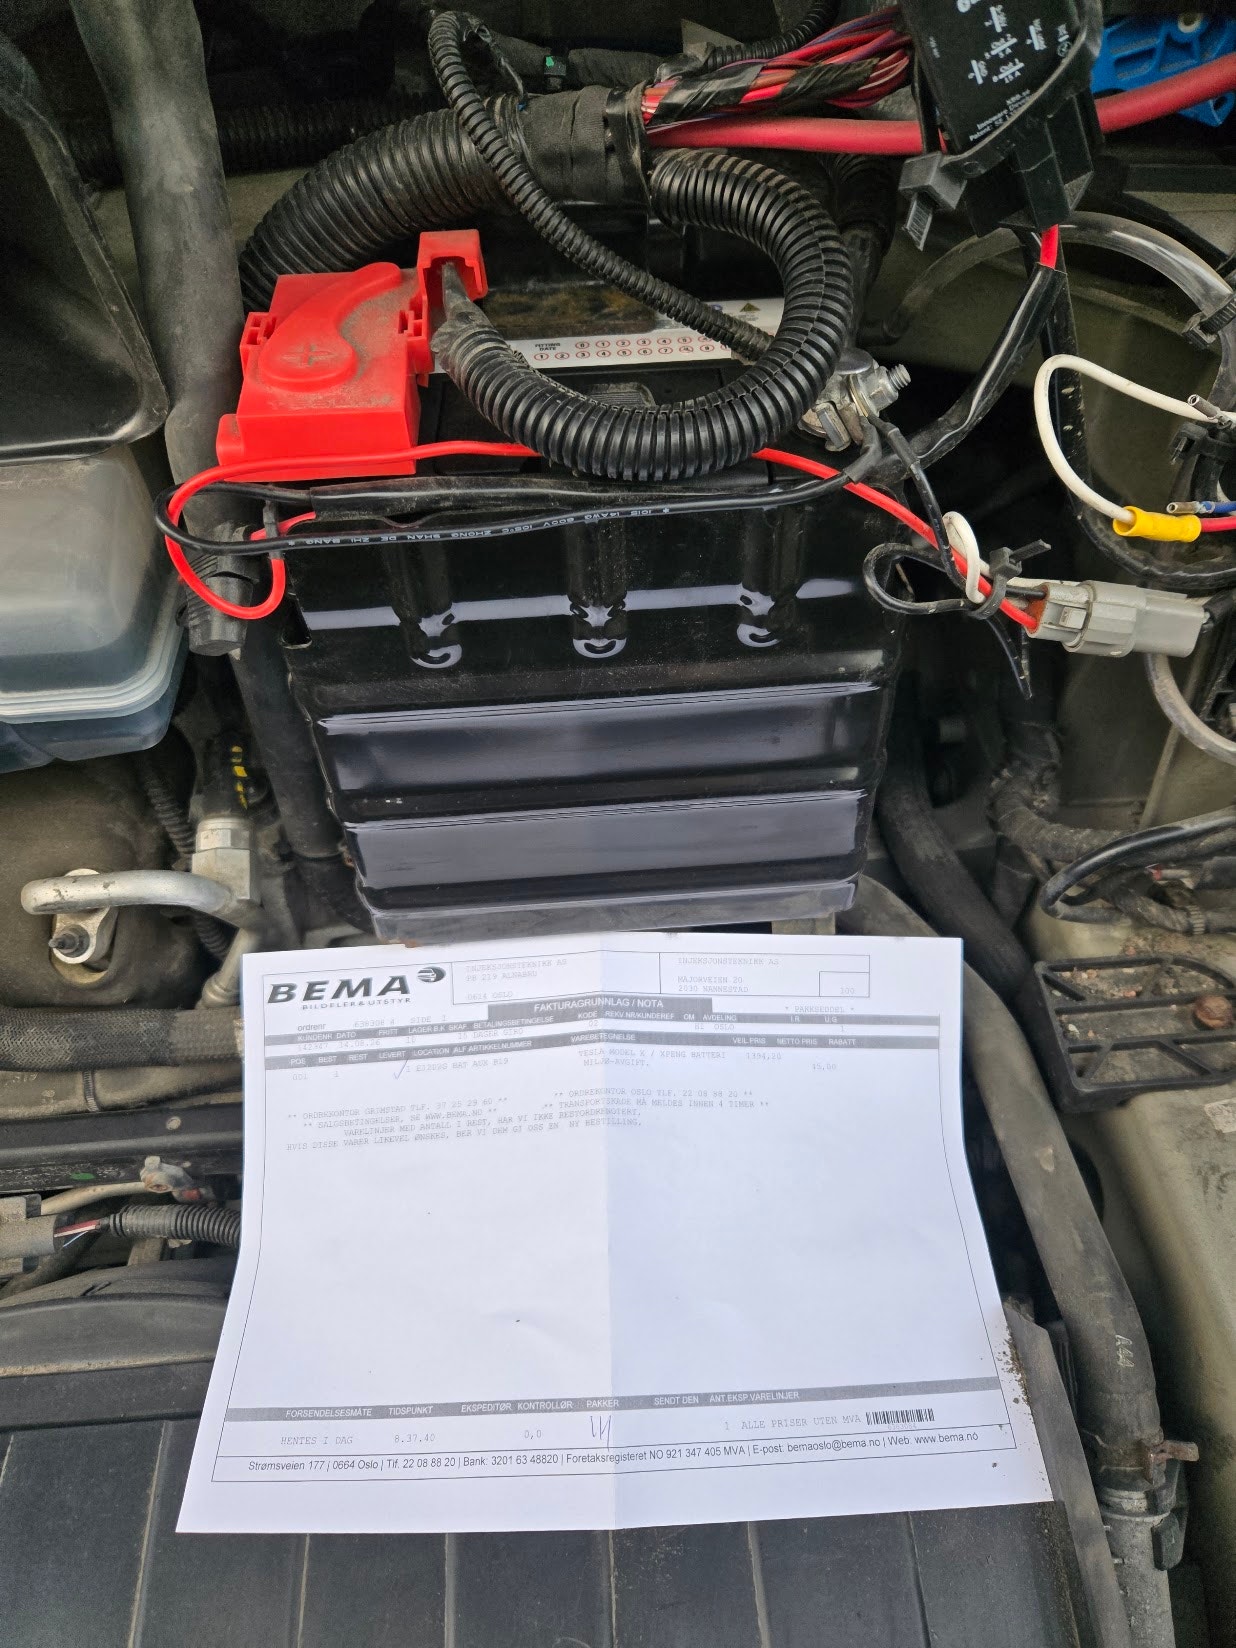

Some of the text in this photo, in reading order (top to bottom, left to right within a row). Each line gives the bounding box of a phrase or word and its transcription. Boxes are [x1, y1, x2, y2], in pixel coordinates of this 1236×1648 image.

[543, 516, 575, 527] 600V
[584, 510, 620, 520] 14AWG
[450, 530, 492, 538] ZHONG
[556, 958, 568, 966] AS
[678, 957, 764, 966] INJEKSJONSTEKNIKK
[501, 970, 538, 980] ALNABRU
[267, 974, 410, 1004] BEMA
[492, 990, 513, 999] OSLO
[702, 985, 749, 993] NANNESTAD
[302, 998, 411, 1010] BILDELER&UTSTYR
[534, 996, 664, 1012] FAKTURAGRUNNLAG NOTA
[298, 1022, 326, 1032] ordrenr
[410, 1015, 432, 1024] SIDE
[298, 1032, 333, 1042] KUNDENR
[336, 1031, 356, 1039] DATO
[408, 1025, 433, 1034] LAGER
[473, 1015, 554, 1029] BETALINGSBETINGELSE
[578, 1011, 598, 1020] KODE
[702, 1014, 737, 1022] AVDELING
[473, 1029, 500, 1038] DAGER
[504, 1028, 524, 1036] GIRO
[714, 1023, 735, 1031] OSLO
[290, 1058, 306, 1066] POS
[318, 1055, 337, 1063] BEST
[349, 1053, 368, 1062] REST
[378, 1050, 406, 1059] LEVERT
[414, 1047, 450, 1057] LOCATION
[467, 1040, 533, 1053] ARTIKKELNUMMER
[570, 1032, 636, 1042] VAREBETEGNELSE
[452, 1061, 469, 1069] BAT
[472, 1059, 488, 1068] AUX
[660, 1050, 687, 1058] XPENG
[690, 1051, 726, 1059] BATTERI
[568, 1088, 626, 1098] ORDREKONTOR
[559, 1097, 632, 1109] TRANSPORTSKADE
[636, 1097, 647, 1106] MÅ
[651, 1099, 683, 1107] MELDES
[688, 1100, 714, 1108] INNEN
[302, 1109, 360, 1120] ORDREKONTOR
[364, 1105, 406, 1116] GRIMSTAD
[318, 1108, 483, 1129] SALGSBETINGELSER, SE WWW.BEMA.NO
[344, 1125, 395, 1137] VARELINJER
[399, 1124, 416, 1133] MED
[420, 1121, 452, 1131] ANTALL
[467, 1118, 491, 1128] REST,
[498, 1116, 514, 1124] HAR
[533, 1113, 554, 1121] IKKE
[286, 1142, 308, 1151] HVIS
[312, 1140, 338, 1149] DISSE
[343, 1138, 369, 1146] VARER
[374, 1134, 410, 1144] LIKEVEL
[456, 1129, 472, 1138] BER
[492, 1126, 508, 1135] DEM
[527, 1123, 544, 1132] OSS
[570, 1120, 580, 1128] NY
[286, 1396, 698, 1418] FORSENDELSESMÅTE TIDSPUNKT EKSPEDITØR KONTROLLØR PAKKER SENDT DEN
[280, 1414, 862, 1445] HENTES DAG 8.37.40 0,0 1 ALLE PRISER UTEN MVA
[248, 1432, 978, 1471] Strømsveien 177 0664 Oslo Tlf. 22 08 88 20 Bank: 3201 63 48820 Foretaksregisteret NO 921 347 405 MVA E-post: bemaoslo@bema.no Web: www.bema.no
